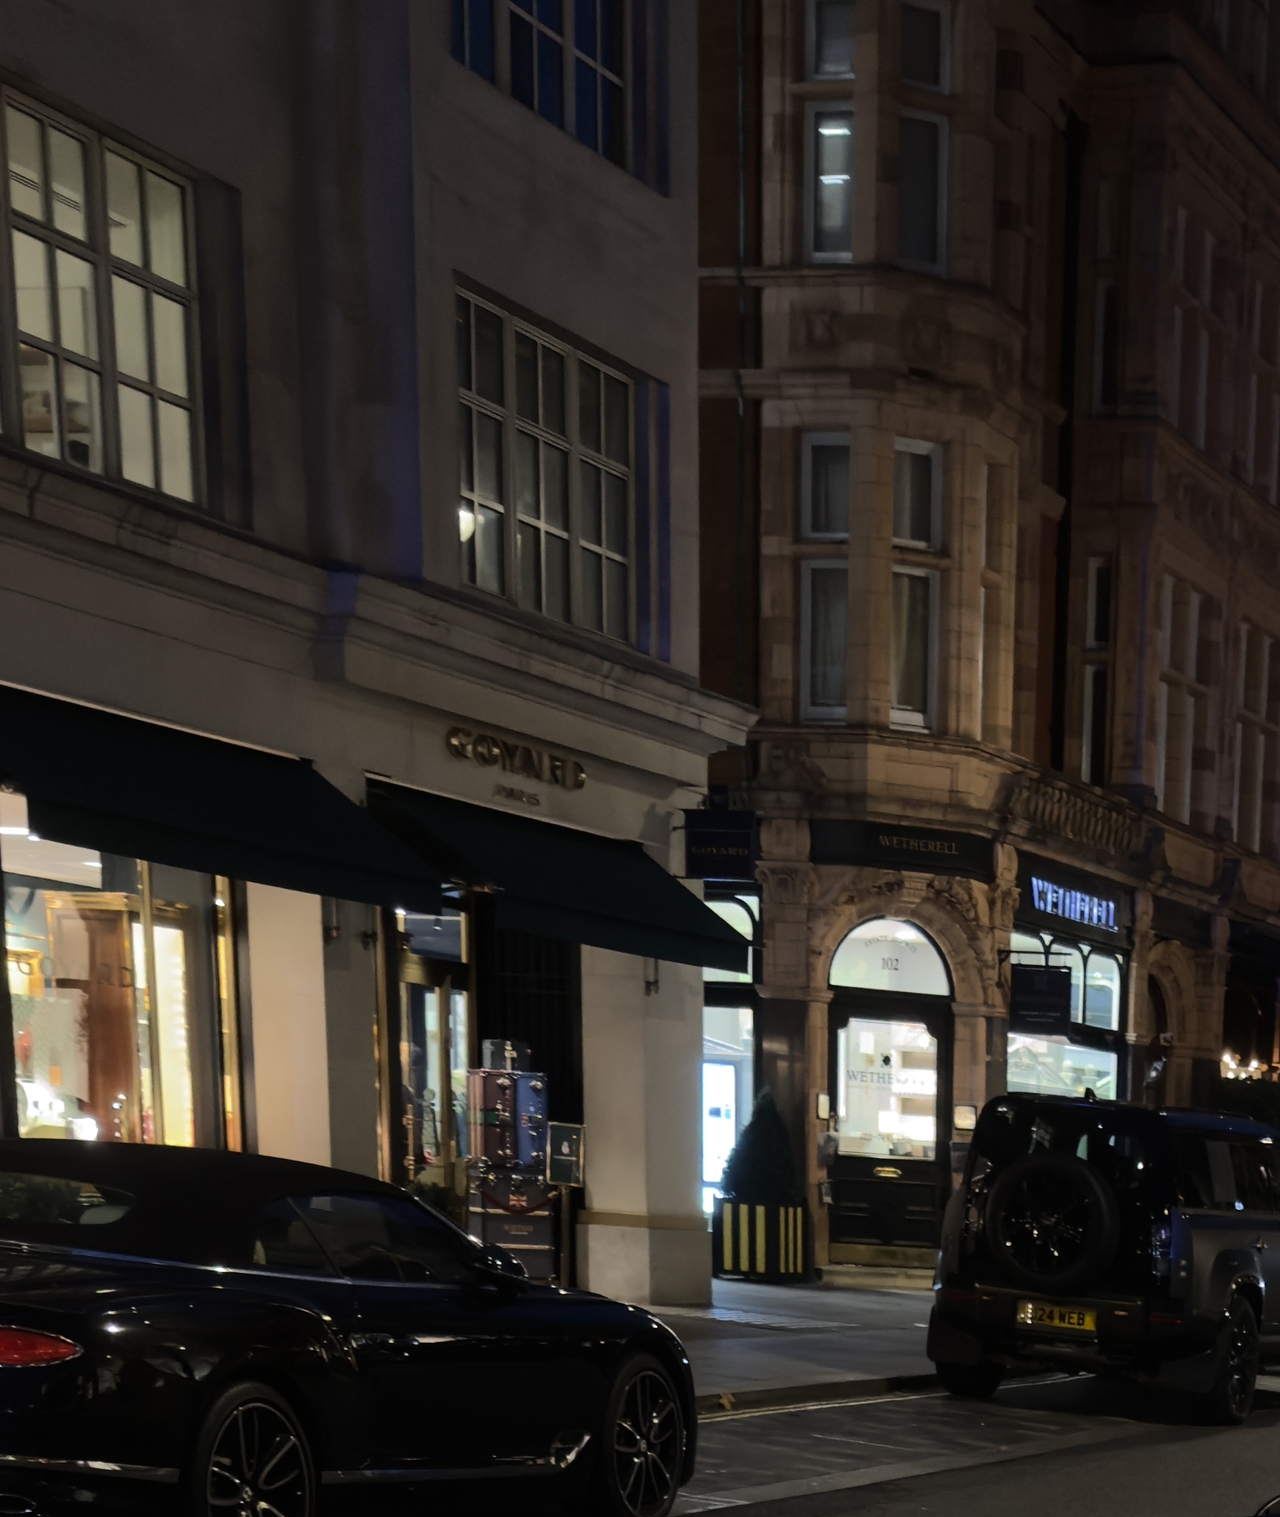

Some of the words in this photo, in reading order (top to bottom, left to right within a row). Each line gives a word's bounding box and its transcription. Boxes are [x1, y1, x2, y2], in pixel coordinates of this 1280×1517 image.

[446, 726, 588, 792] GOYARD
[878, 834, 959, 855] WETHERELL
[1031, 876, 1119, 933] WETHERELL
[881, 957, 900, 971] 102
